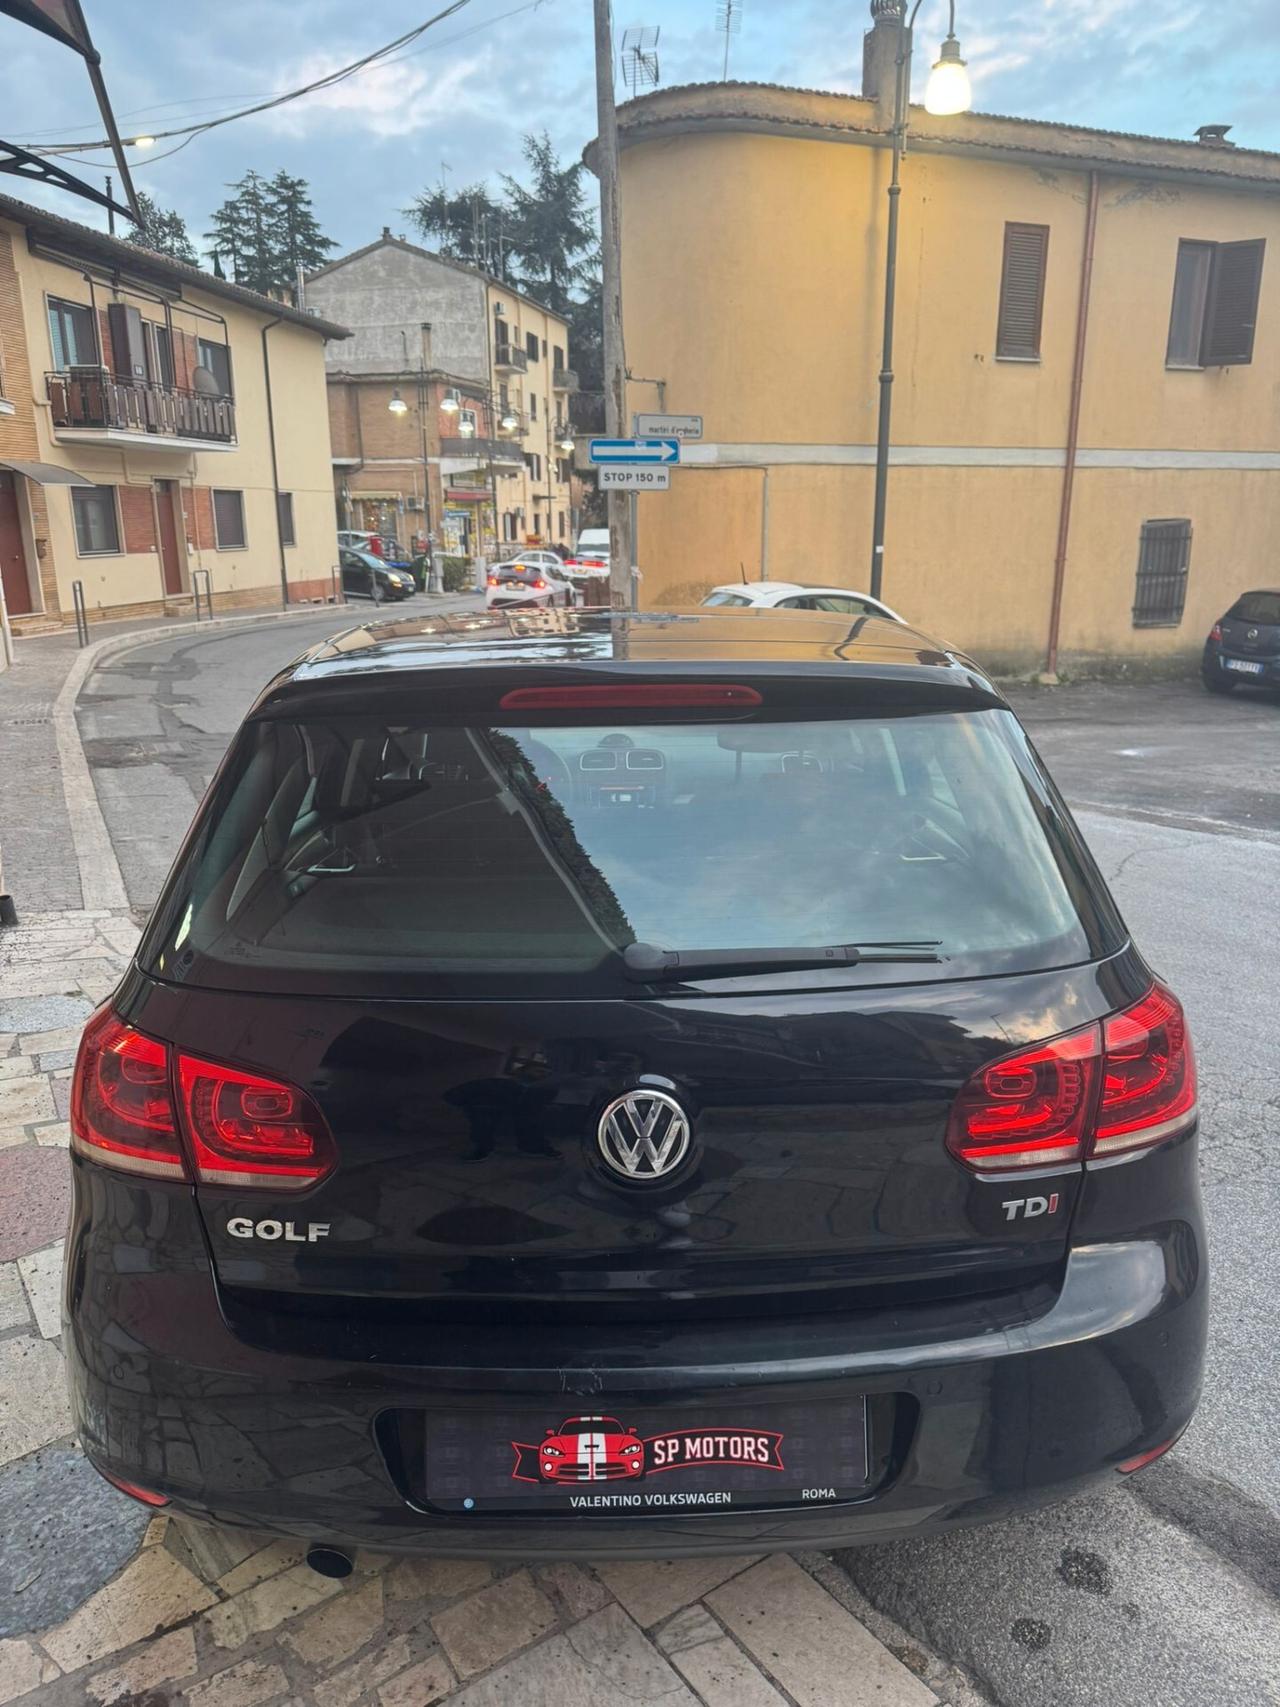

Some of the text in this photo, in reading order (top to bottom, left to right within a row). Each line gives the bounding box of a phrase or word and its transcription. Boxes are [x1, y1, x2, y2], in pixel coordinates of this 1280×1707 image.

[604, 472, 632, 482] STOP
[636, 473, 654, 482] 150
[226, 1217, 331, 1242] GOLF
[653, 1436, 769, 1465] SP MOTORS
[570, 1492, 732, 1508] VALENTINO VOLKSWAGEN
[801, 1488, 836, 1500] ROMA
